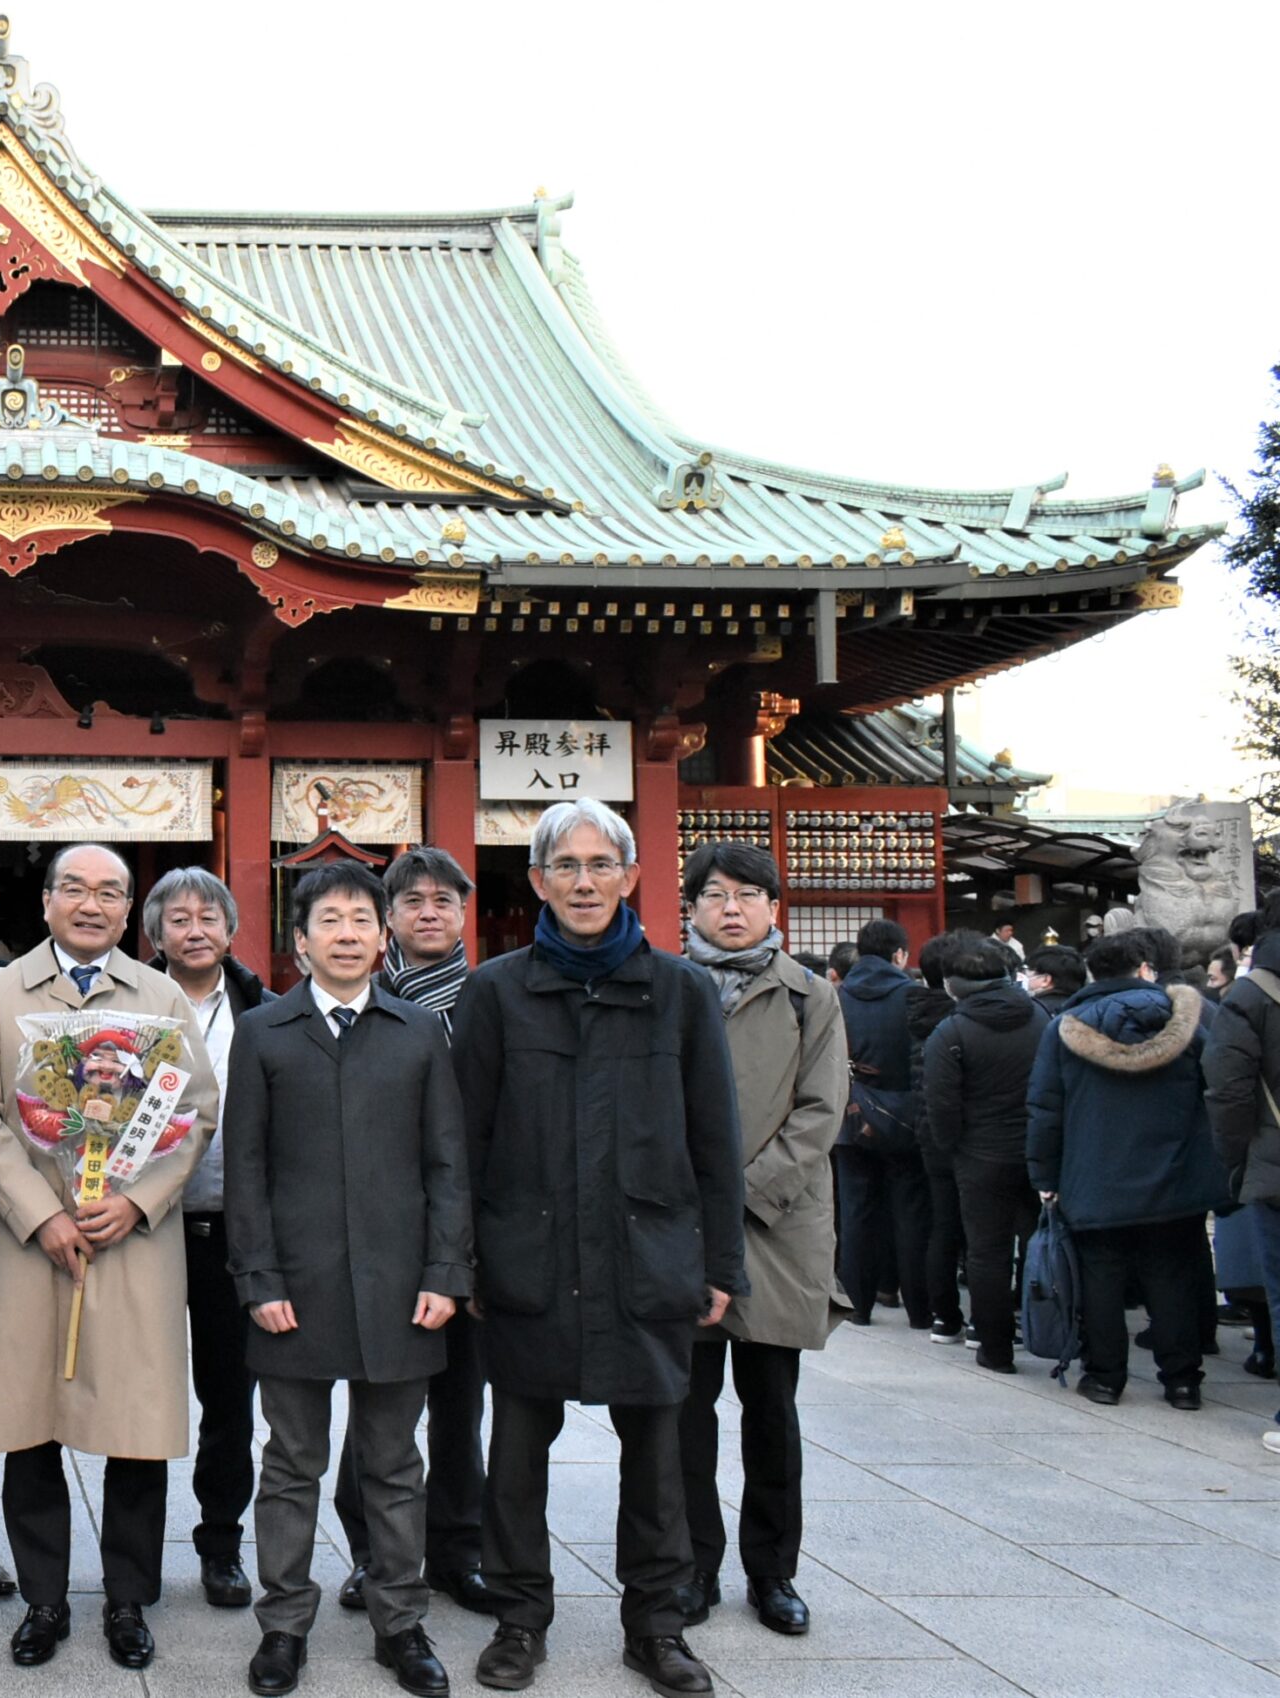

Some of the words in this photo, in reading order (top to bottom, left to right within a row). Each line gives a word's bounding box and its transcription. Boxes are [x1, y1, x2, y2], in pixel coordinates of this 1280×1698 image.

[494, 730, 612, 758] 昇殿参拝
[526, 768, 581, 791] 入口
[120, 1094, 163, 1160] 神田明神
